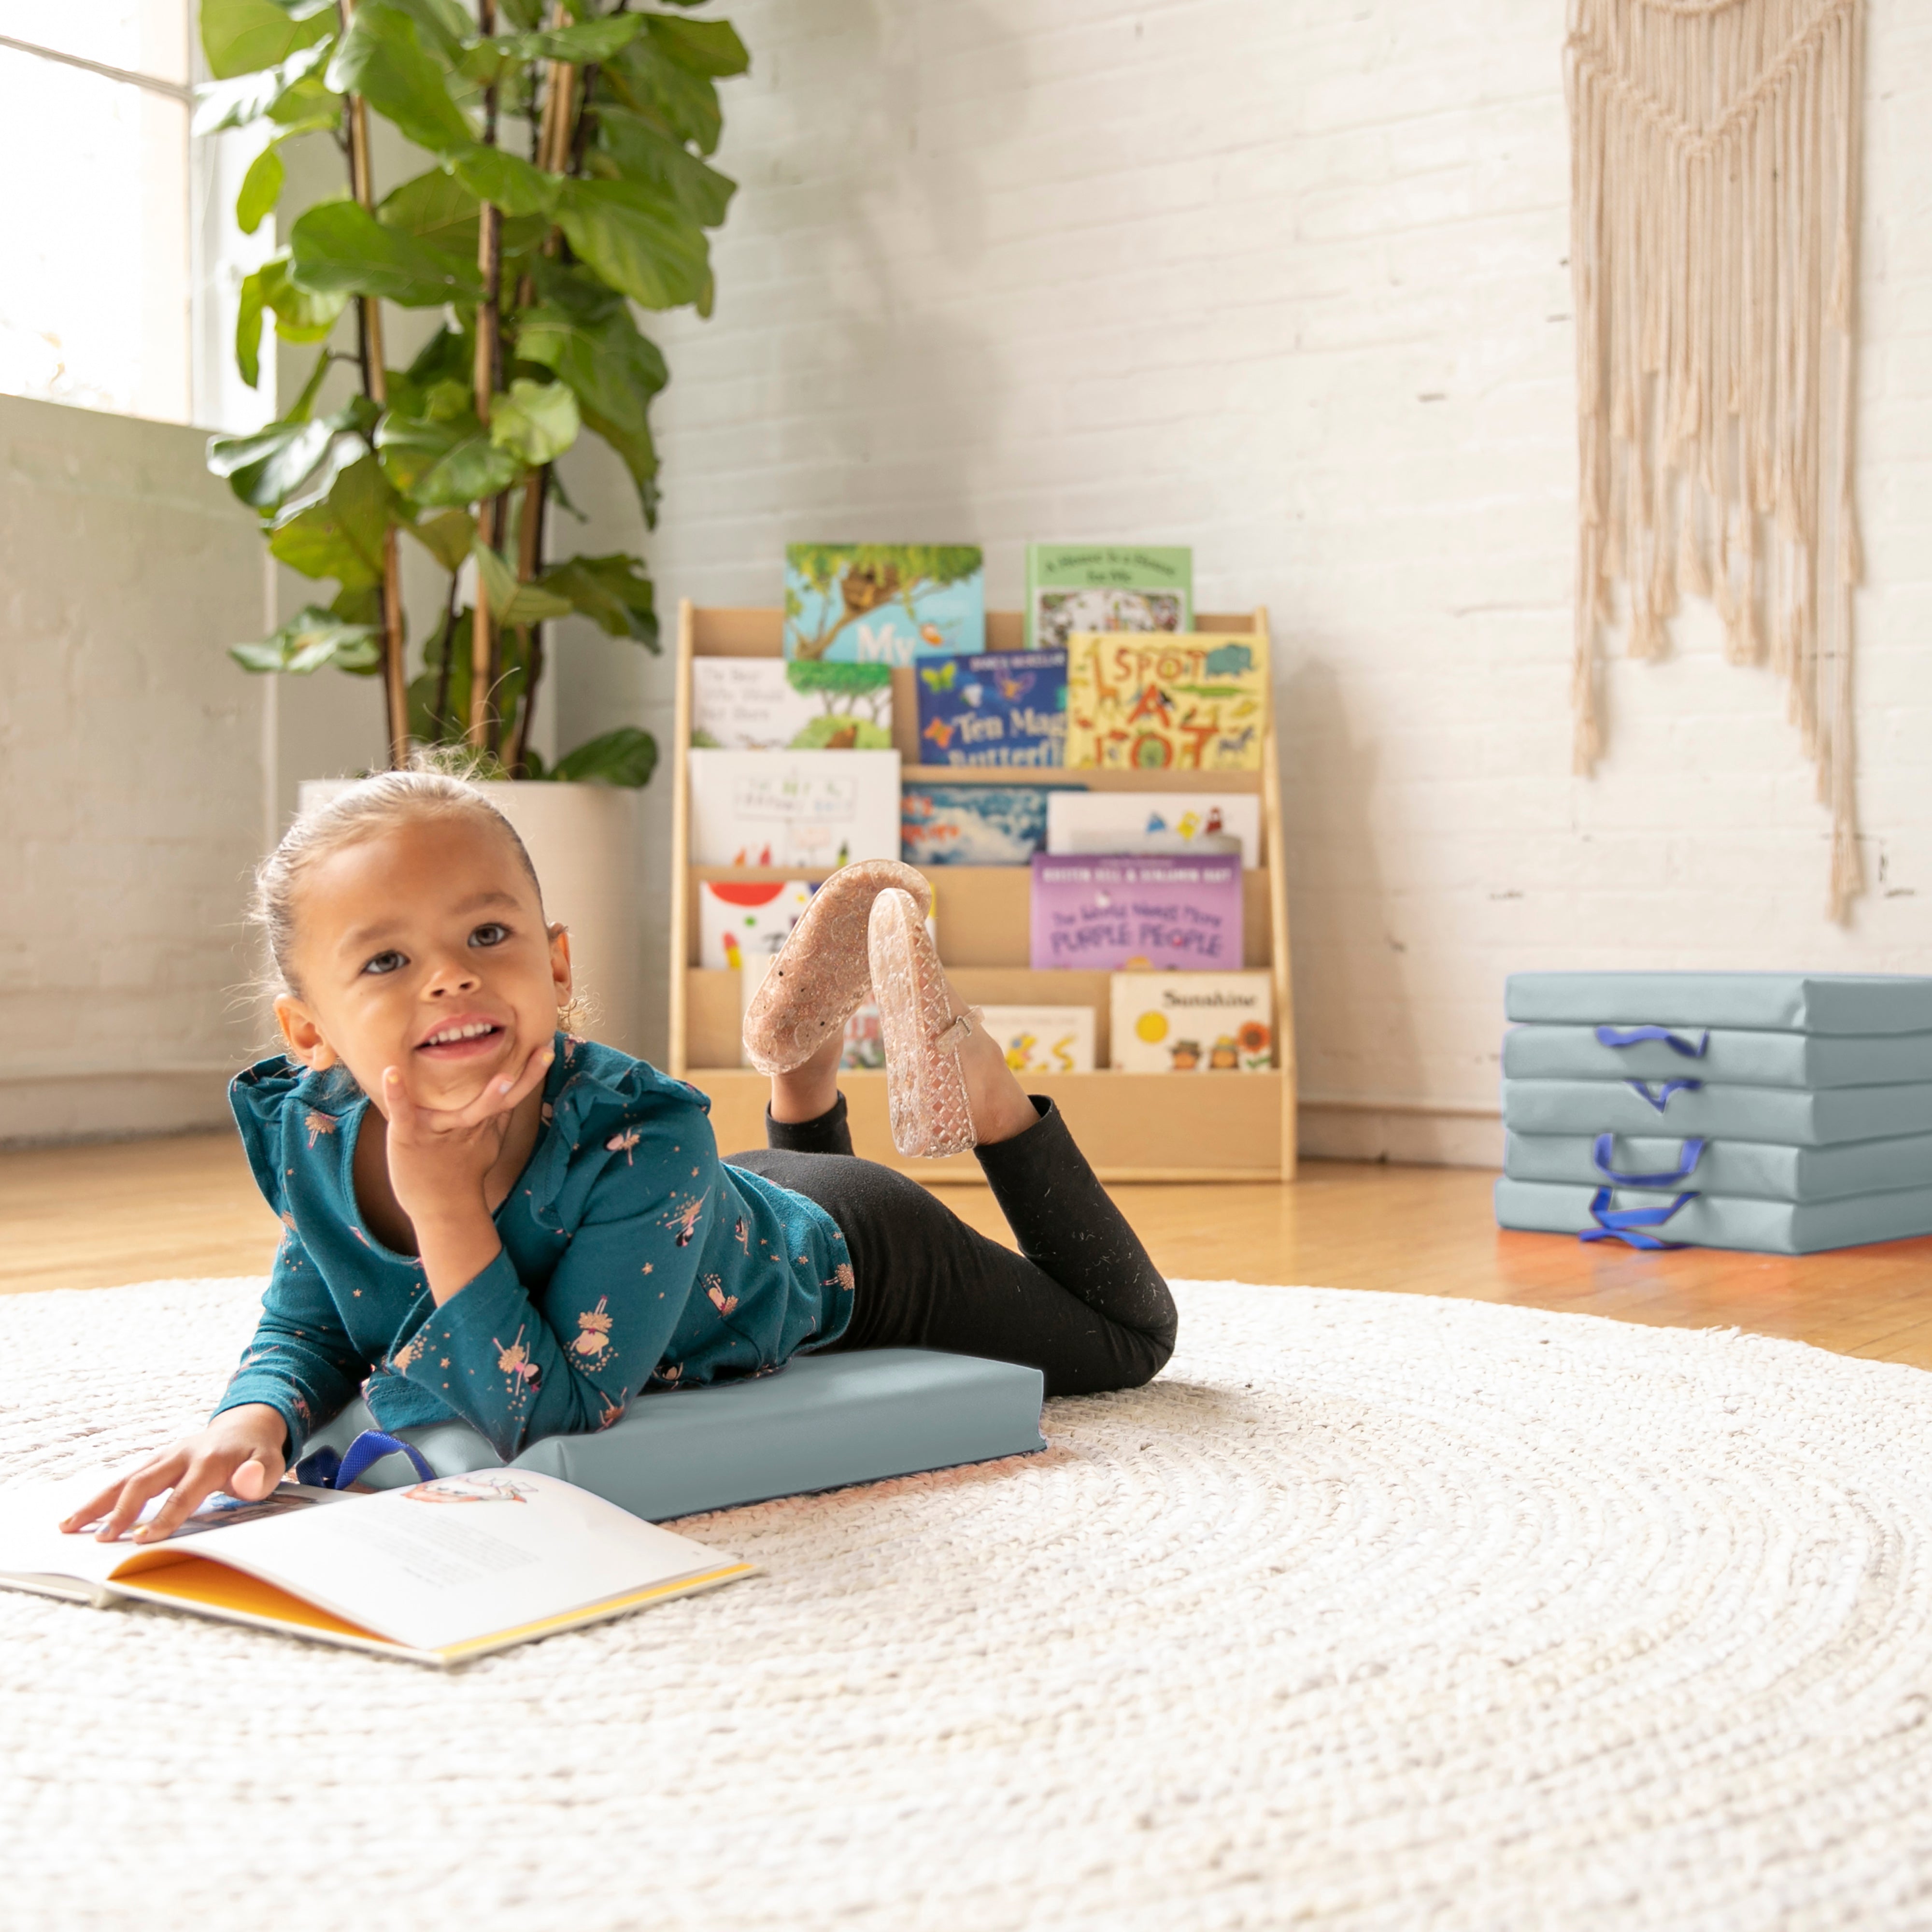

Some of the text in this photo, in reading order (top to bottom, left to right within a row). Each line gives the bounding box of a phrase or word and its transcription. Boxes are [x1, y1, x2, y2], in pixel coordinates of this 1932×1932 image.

[857, 624, 916, 666] My
[1114, 646, 1207, 683] SPOT
[1126, 683, 1171, 729] A
[952, 707, 1066, 743] Ten Mag
[948, 738, 1066, 767] Butterfl
[1051, 923, 1221, 957] PURPLE PEOPLE
[1162, 989, 1257, 1009] Sunshine
